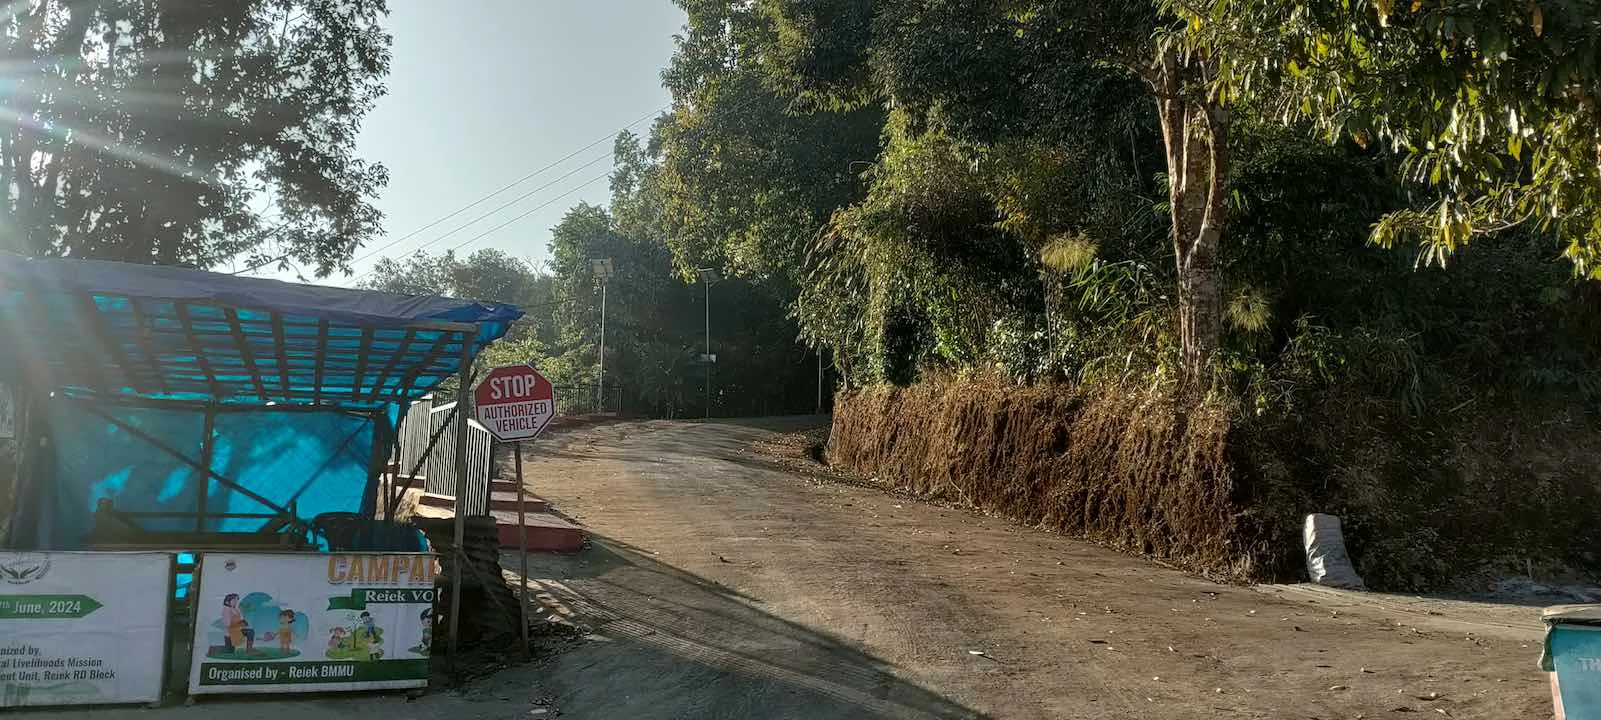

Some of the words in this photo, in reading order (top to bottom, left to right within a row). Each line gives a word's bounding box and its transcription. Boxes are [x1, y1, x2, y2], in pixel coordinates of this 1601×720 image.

[489, 374, 536, 399] STOP
[484, 402, 547, 420] AUTHORIZED
[495, 417, 538, 432] VEHICLE
[365, 590, 406, 602] Reiek
[13, 600, 45, 615] June,
[48, 600, 81, 614] 2024
[13, 659, 65, 669] Livelihoods
[67, 657, 102, 668] Mission
[73, 670, 87, 680] RD
[89, 670, 116, 680] Block
[208, 667, 262, 682] Organised
[265, 667, 278, 680] by
[288, 665, 319, 678] Reiek
[321, 665, 354, 677] BMMU
